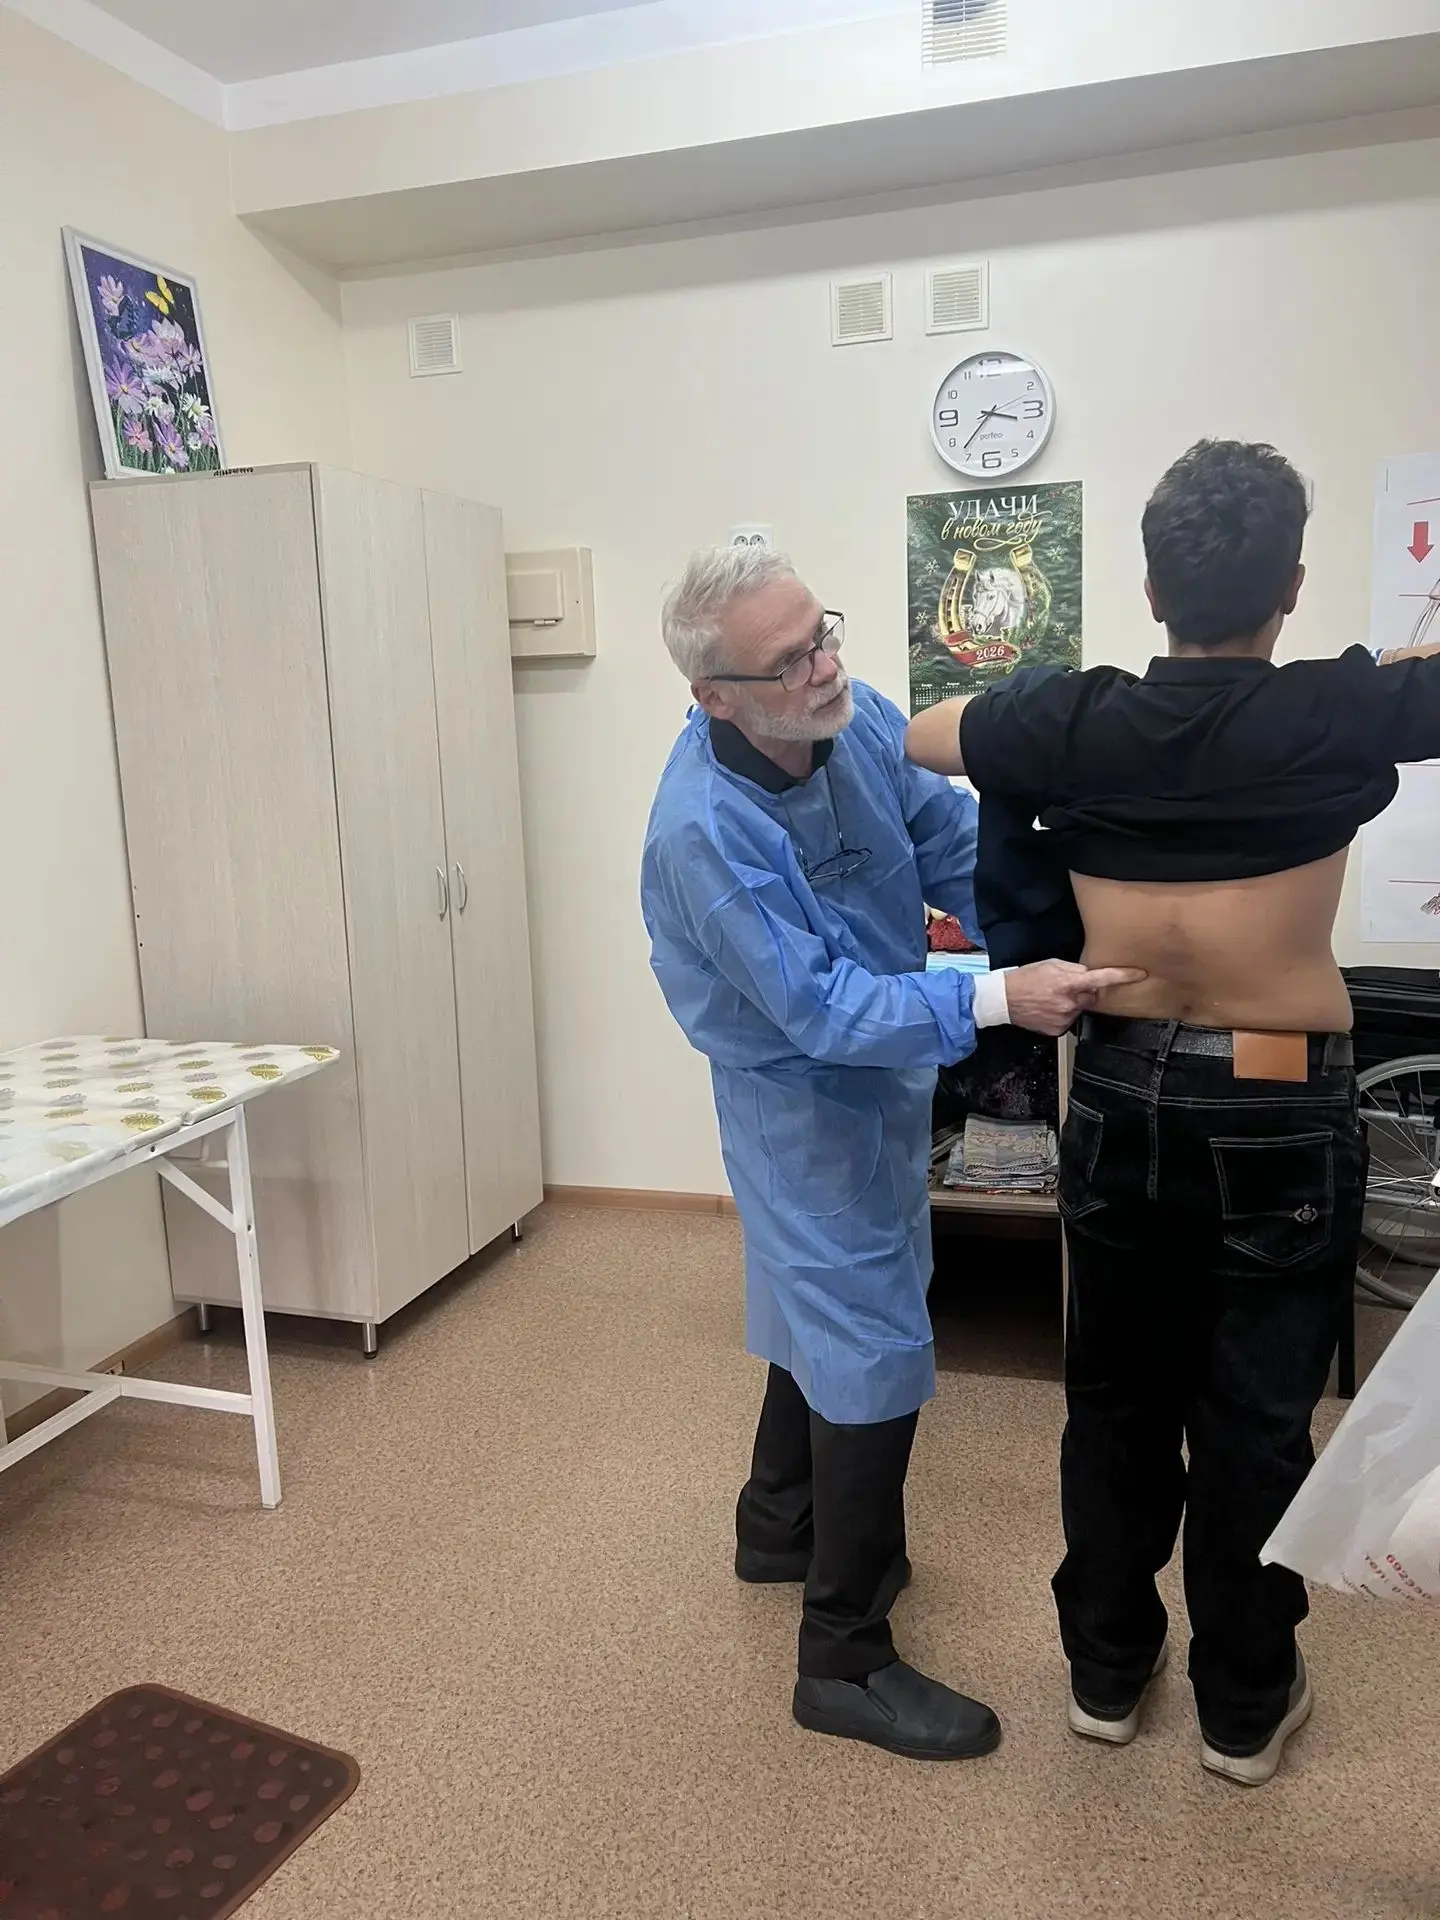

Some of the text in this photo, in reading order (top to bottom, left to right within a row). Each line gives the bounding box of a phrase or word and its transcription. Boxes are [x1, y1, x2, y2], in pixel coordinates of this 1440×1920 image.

[964, 371, 971, 380] 11
[1026, 381, 1035, 391] 2
[948, 390, 958, 400] 10
[1023, 400, 1044, 420] 3
[939, 409, 959, 428] 9
[1026, 430, 1034, 440] 4
[949, 438, 957, 448] 8
[965, 453, 972, 463] 7
[1011, 449, 1019, 458] 5
[982, 451, 1002, 469] 6
[948, 494, 1038, 524] УДАЧИ
[941, 517, 954, 541] в
[953, 517, 1002, 540] новом
[976, 645, 1005, 661] 2026
